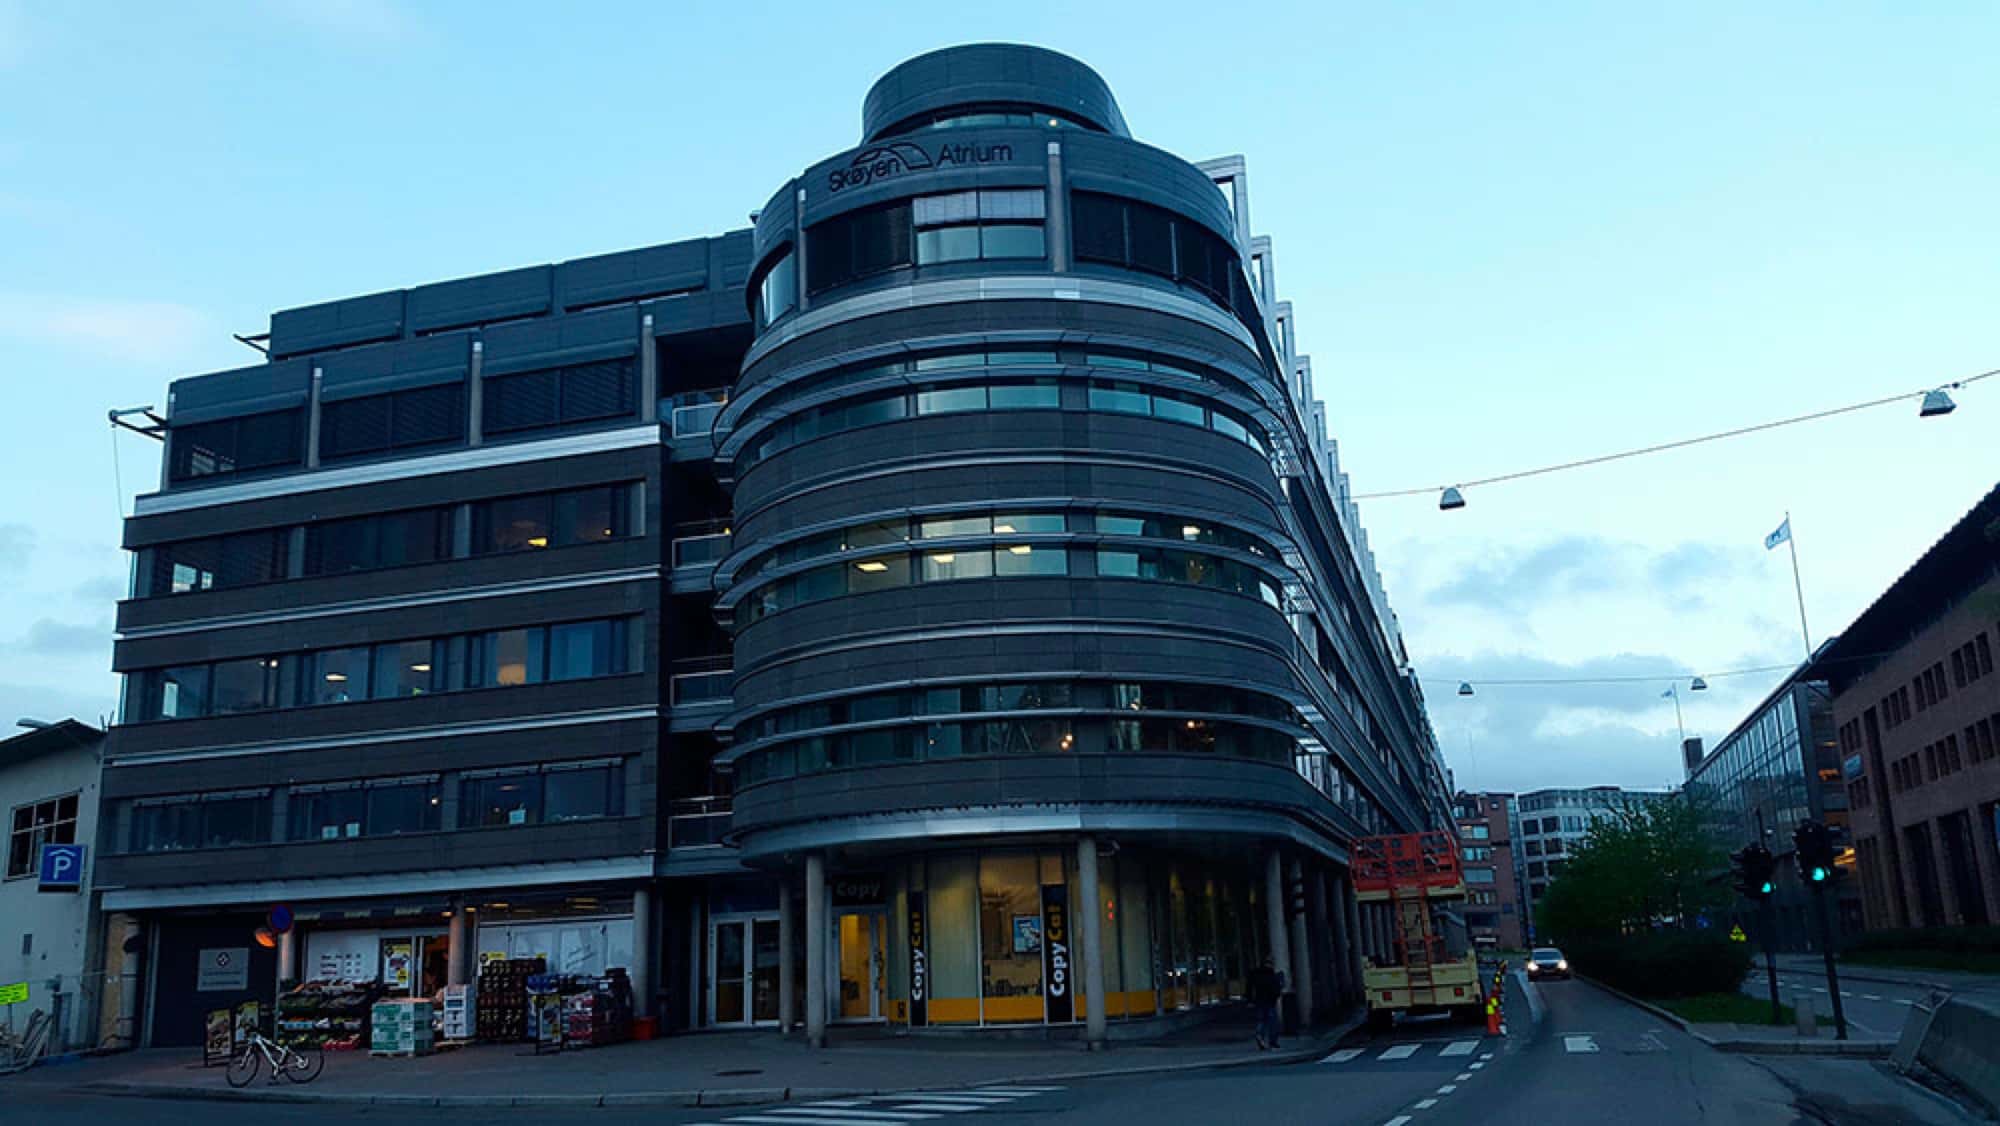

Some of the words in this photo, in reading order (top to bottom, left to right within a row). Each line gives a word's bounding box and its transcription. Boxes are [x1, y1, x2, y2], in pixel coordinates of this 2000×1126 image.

[829, 157, 901, 192] Skøyen
[937, 143, 1013, 167] Atrium
[53, 855, 72, 880] P
[836, 880, 881, 900] Copy
